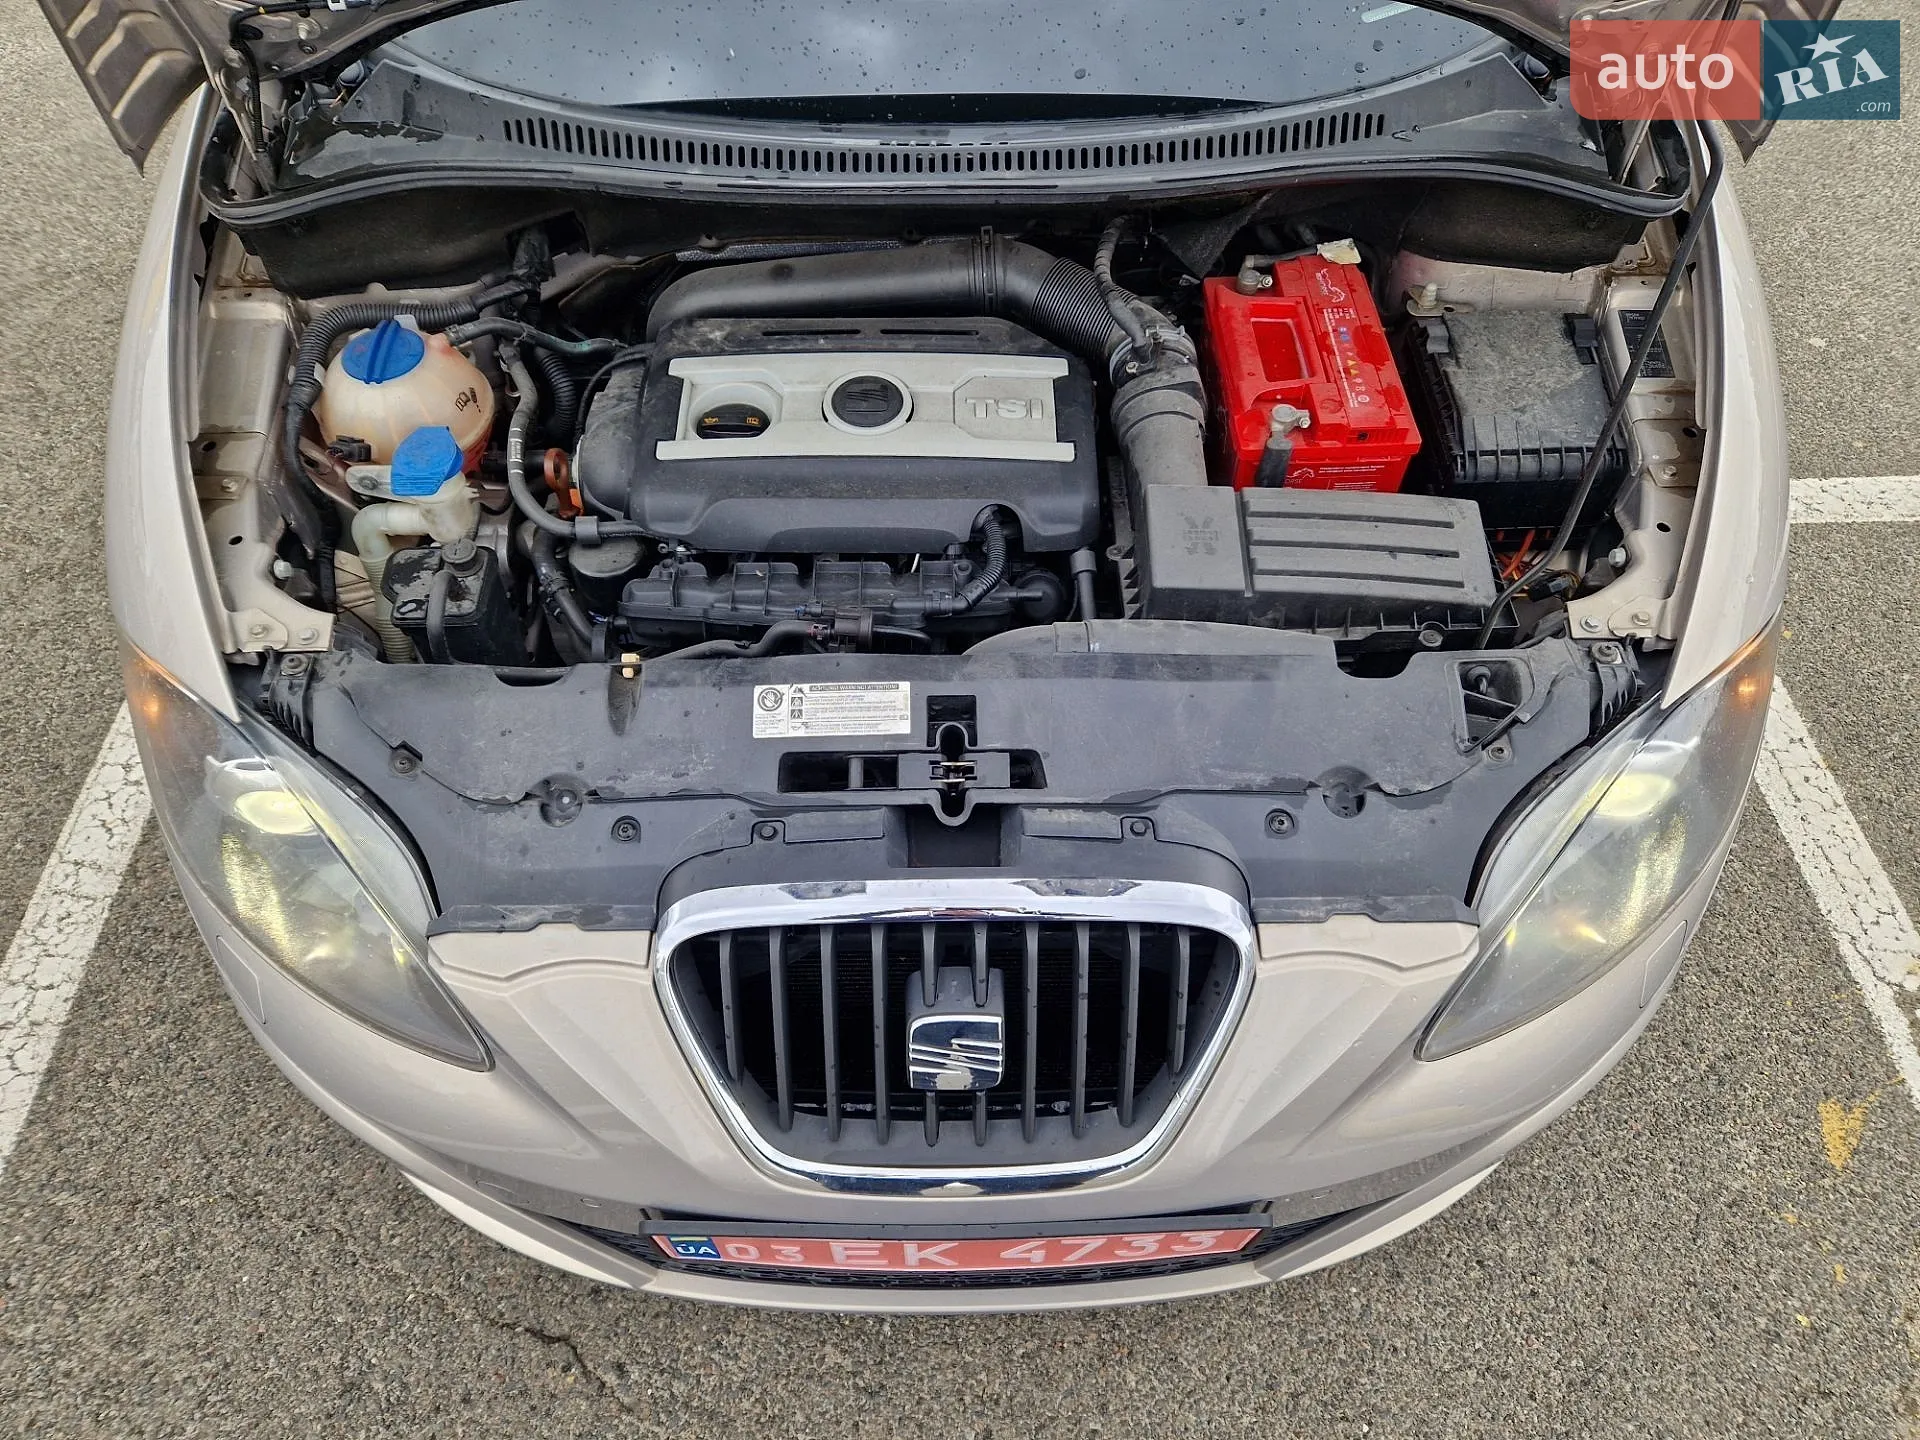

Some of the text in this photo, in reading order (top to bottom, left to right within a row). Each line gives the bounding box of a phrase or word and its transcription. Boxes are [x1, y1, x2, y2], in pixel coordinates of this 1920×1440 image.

[965, 397, 1044, 420] TSI
[675, 1231, 1226, 1266] UA 03 EK 4733
